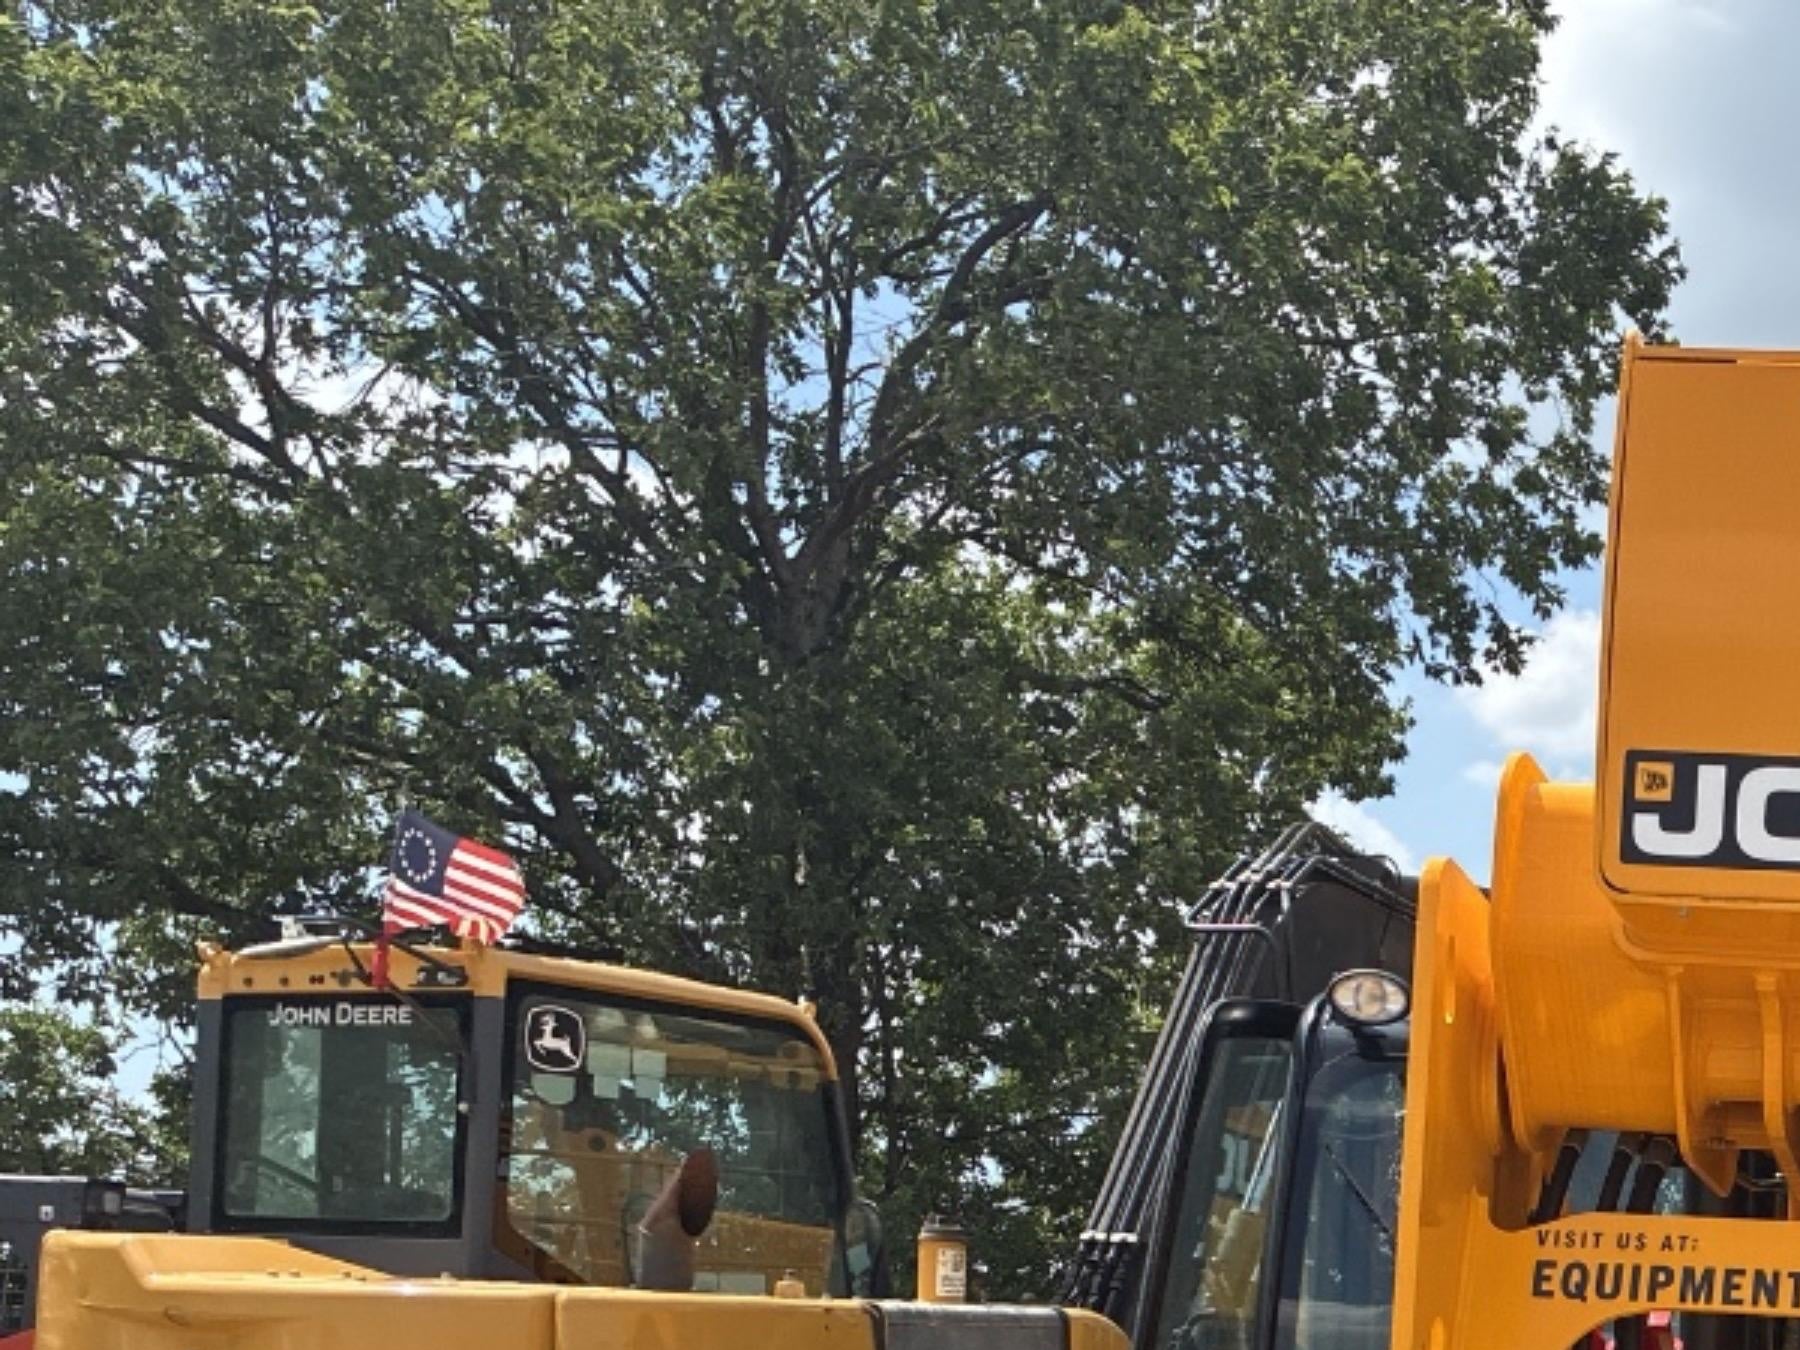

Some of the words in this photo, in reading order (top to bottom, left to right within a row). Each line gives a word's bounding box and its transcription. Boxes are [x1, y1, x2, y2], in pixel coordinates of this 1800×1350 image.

[267, 1003, 331, 1027] JOHN
[335, 1002, 413, 1026] DEERE
[1537, 1229, 1603, 1249] VISIT
[1617, 1232, 1648, 1250] US
[1660, 1235, 1699, 1252] AT:
